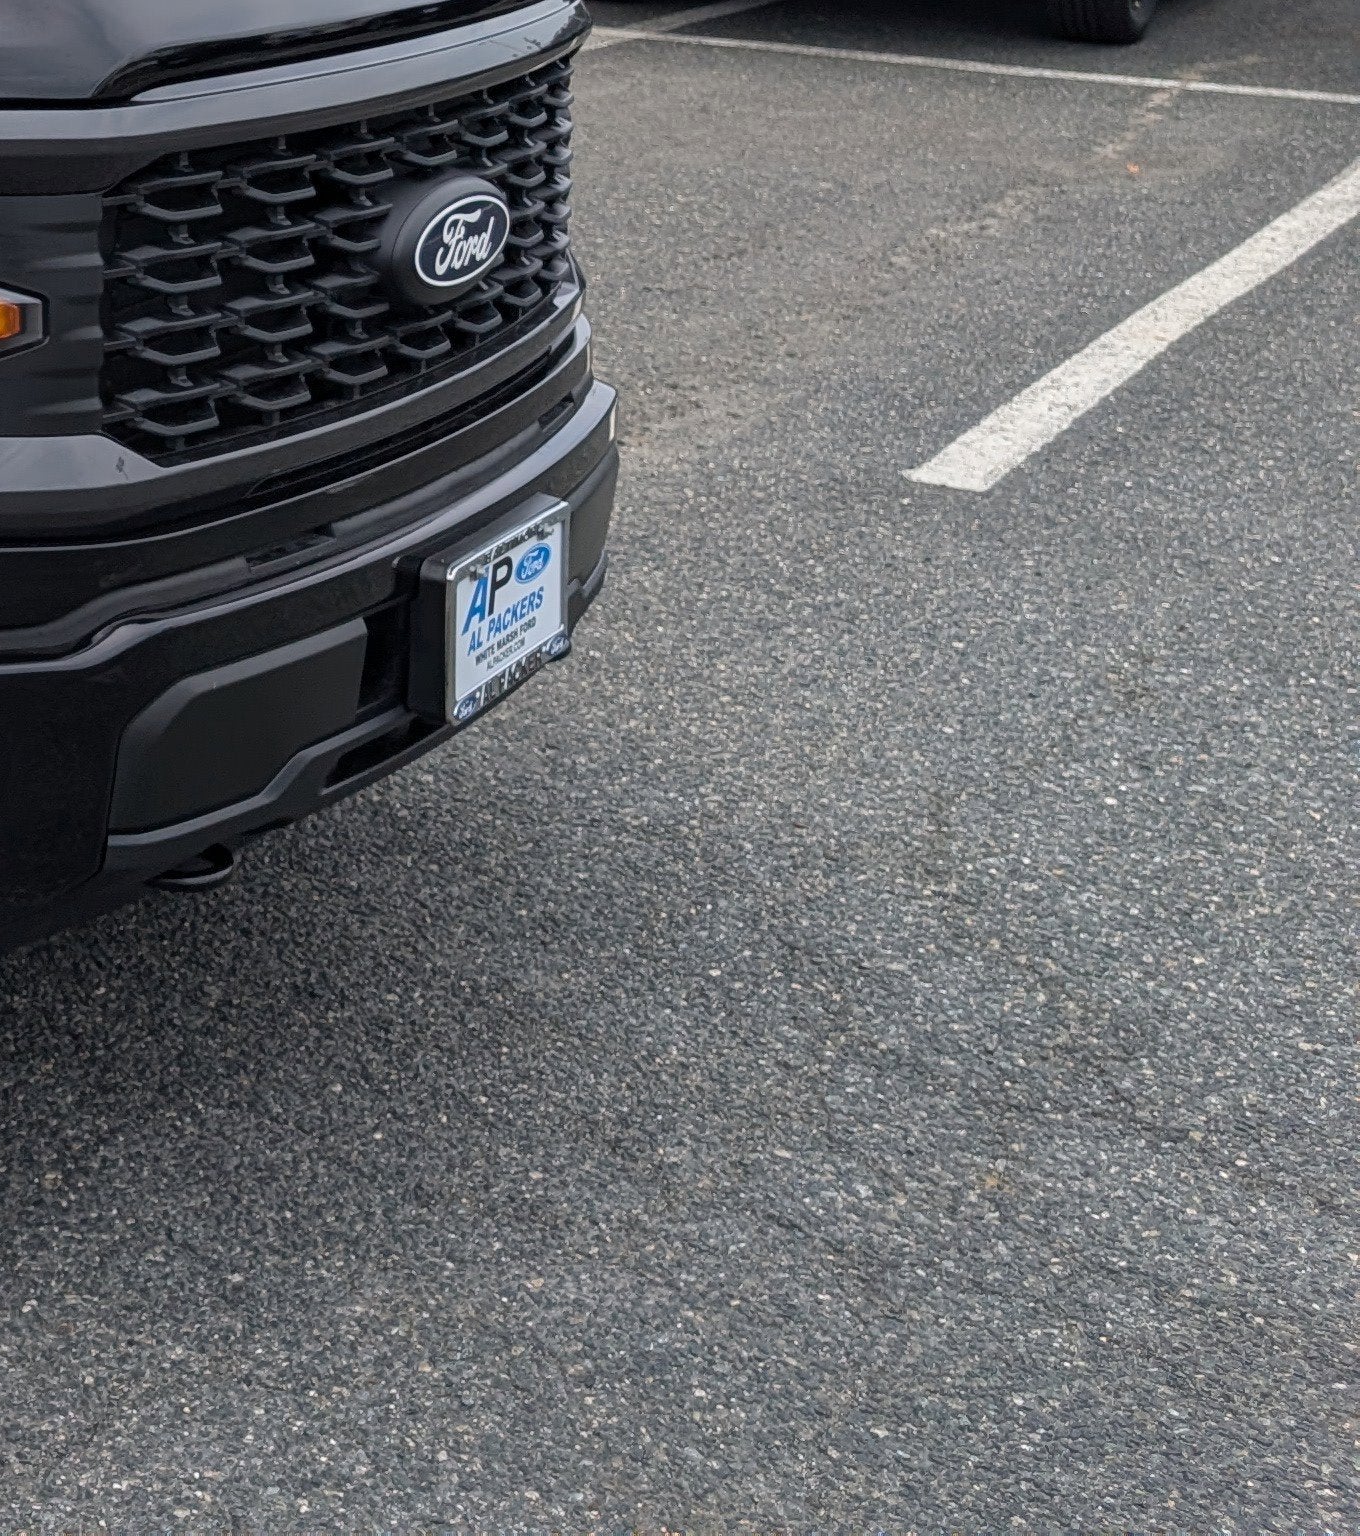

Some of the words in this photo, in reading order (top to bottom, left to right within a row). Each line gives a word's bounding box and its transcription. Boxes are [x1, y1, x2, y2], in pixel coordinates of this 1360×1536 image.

[434, 208, 495, 276] Ford
[461, 555, 513, 636] AP
[466, 625, 484, 657] AL
[486, 585, 545, 642] PACKERS
[475, 643, 496, 666] WHITE
[496, 627, 519, 651] MARSH
[519, 615, 537, 636] FORD
